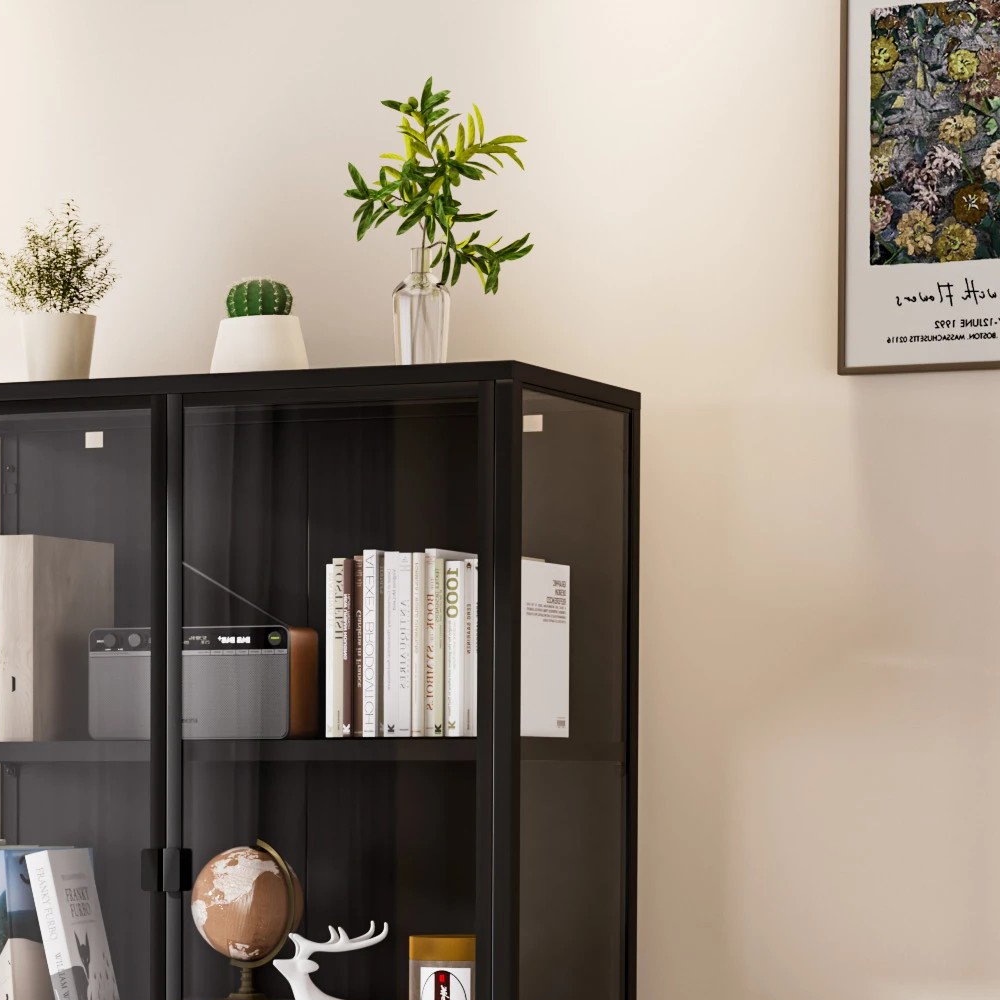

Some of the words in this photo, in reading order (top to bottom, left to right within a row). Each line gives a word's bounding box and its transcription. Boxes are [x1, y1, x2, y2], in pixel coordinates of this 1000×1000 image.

[64, 886, 90, 902] FRANKY
[70, 902, 91, 918] FURBO
[36, 867, 51, 904] FRANKY
[44, 907, 58, 941] FURBO
[54, 952, 68, 989] WILLIAM
